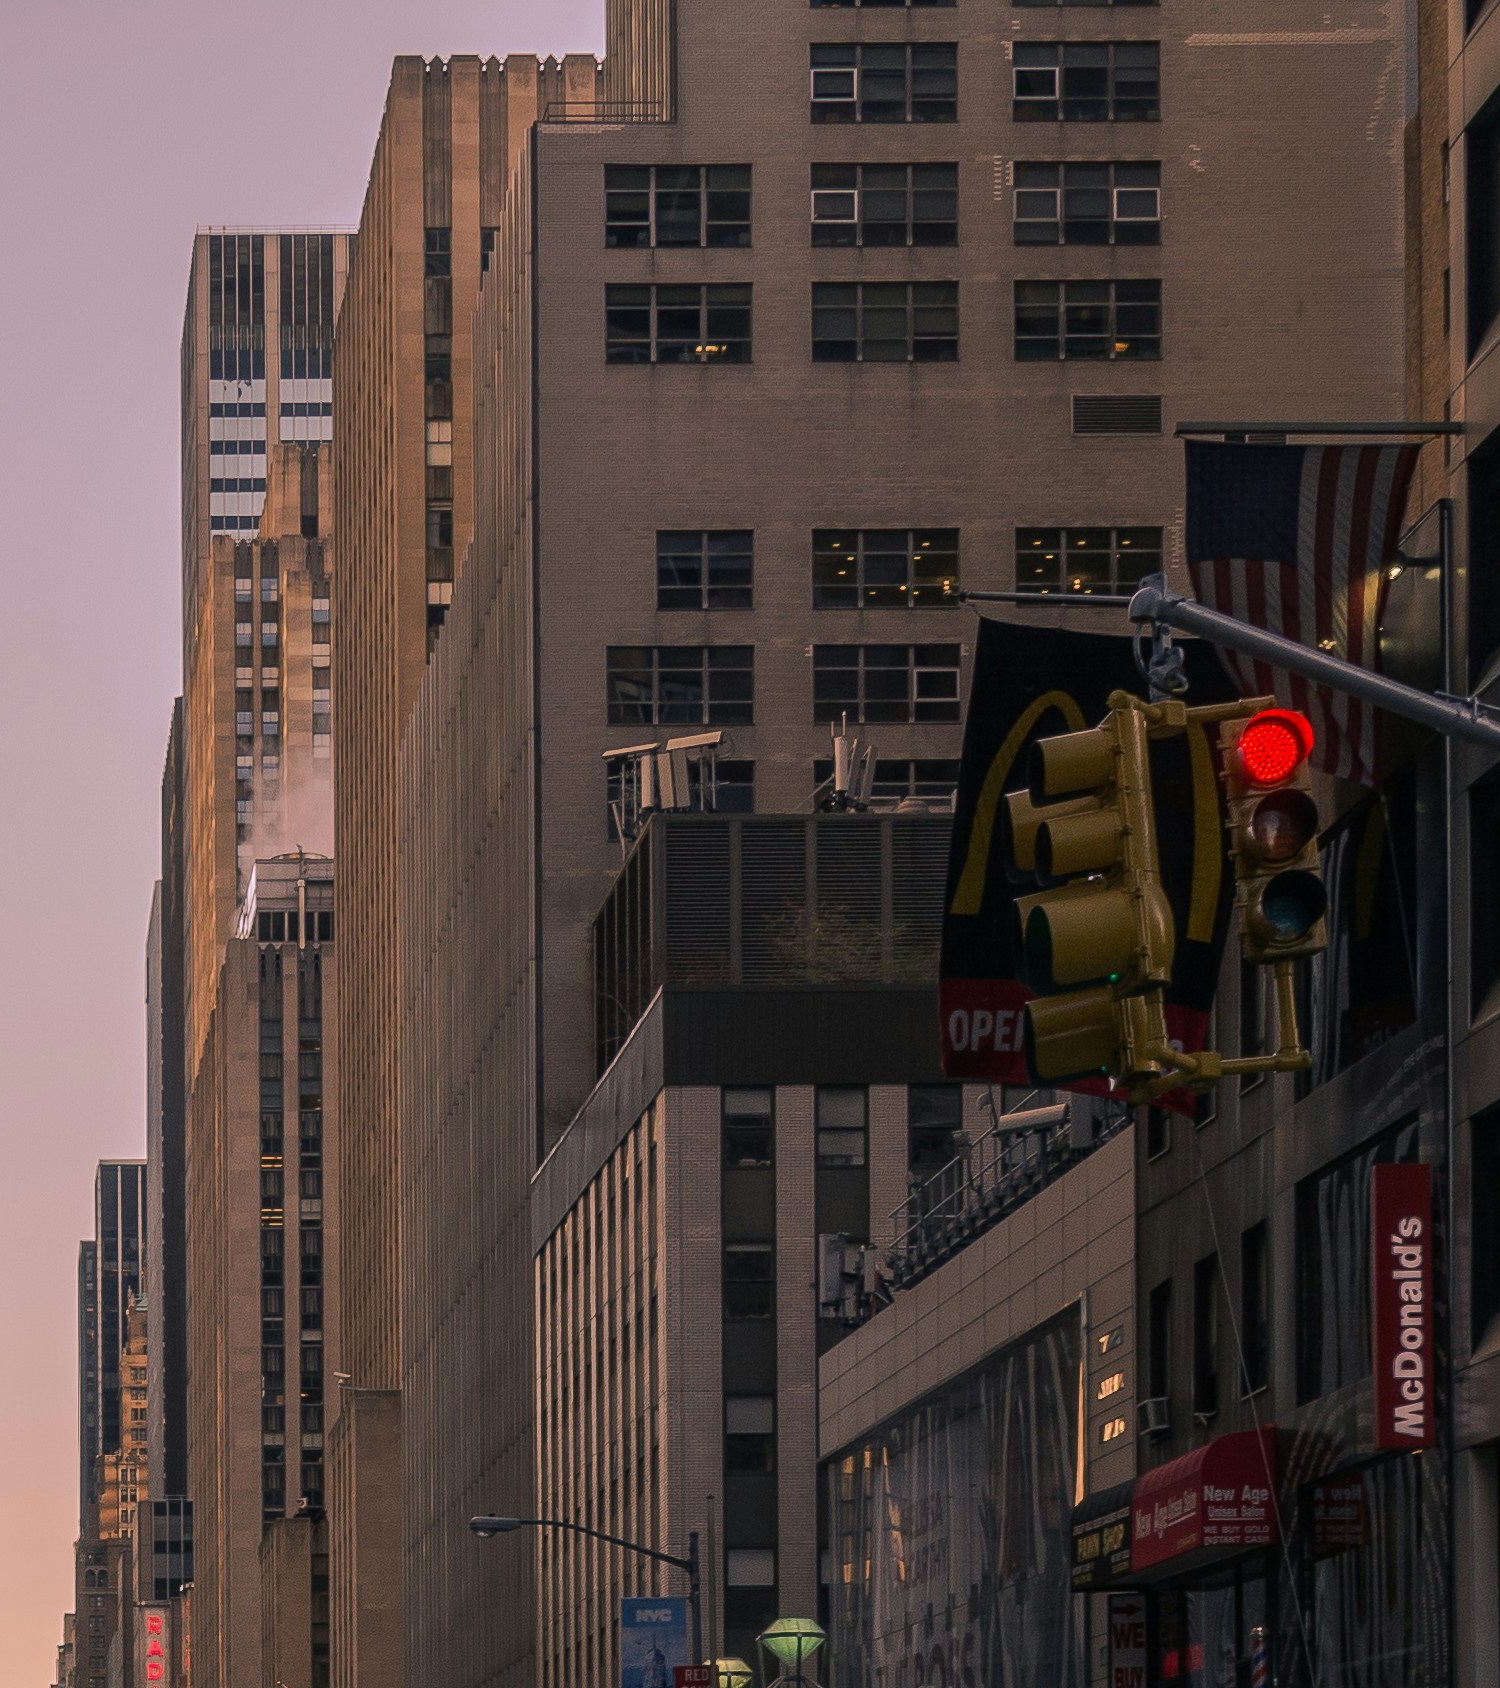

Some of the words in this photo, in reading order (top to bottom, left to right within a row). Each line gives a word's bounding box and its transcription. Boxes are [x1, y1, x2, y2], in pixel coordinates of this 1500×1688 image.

[1391, 1215, 1425, 1438] McDonald's
[1203, 1485, 1235, 1502] New
[1241, 1485, 1269, 1504] Age
[1241, 1506, 1265, 1517] Salon
[1136, 1509, 1150, 1540] New
[1204, 1526, 1218, 1534] WE
[1244, 1525, 1270, 1534] GOLD
[1113, 1623, 1144, 1649] WE
[684, 1668, 709, 1682] RED
